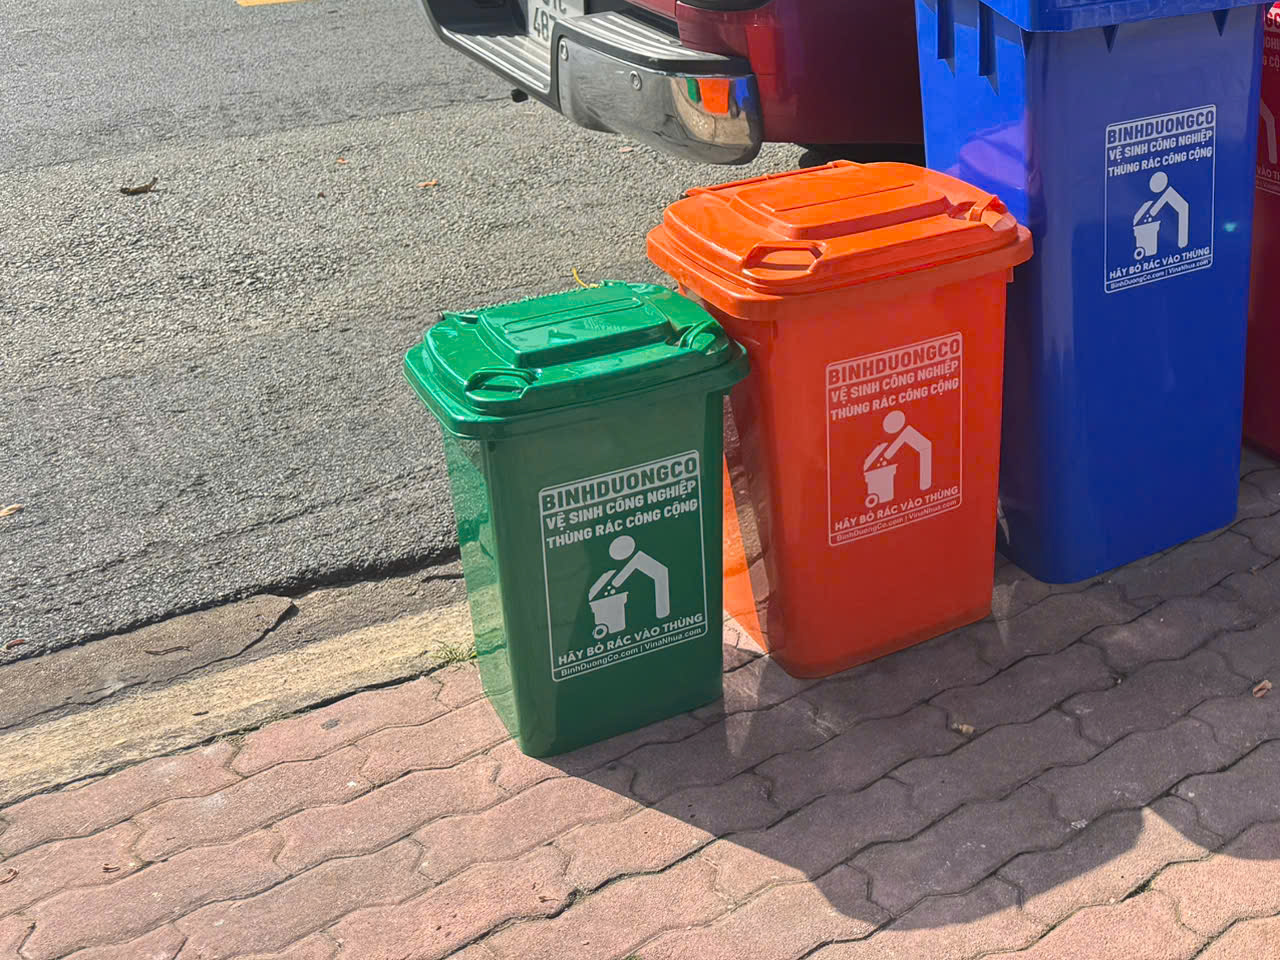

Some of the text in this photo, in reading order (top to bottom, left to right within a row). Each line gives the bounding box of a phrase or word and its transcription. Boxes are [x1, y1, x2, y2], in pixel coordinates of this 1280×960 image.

[1108, 110, 1214, 145] BINHDUONGCO
[1109, 128, 1213, 163] VỆ SINH CÔNG NGHIỆP
[1108, 146, 1213, 177] THÙNG RÁC CÔNG CỘNG
[1109, 246, 1210, 279] HÃY BỎ RÁC VÀO THÙNG
[828, 339, 960, 386] BINHDUONGCO
[831, 360, 959, 404] VỆ SINH CÔNG NGHIỆP
[831, 377, 959, 421] THÙNG RÁC CÔNG CỘNG
[541, 457, 698, 512] BINHDUONGCO
[546, 479, 697, 531] VỆ SINH CÔNG NGHIỆP
[546, 498, 698, 549] THÙNG RÁC CÔNG CỘNG
[835, 486, 959, 531] HÃY BỎ RÁC VÀO THÙNG
[558, 613, 703, 665] HÃY BỎ RÁC VÀO THÙNG
[560, 646, 639, 677] BinhDuongCo.com
[644, 628, 702, 649] VinaNhua.com
